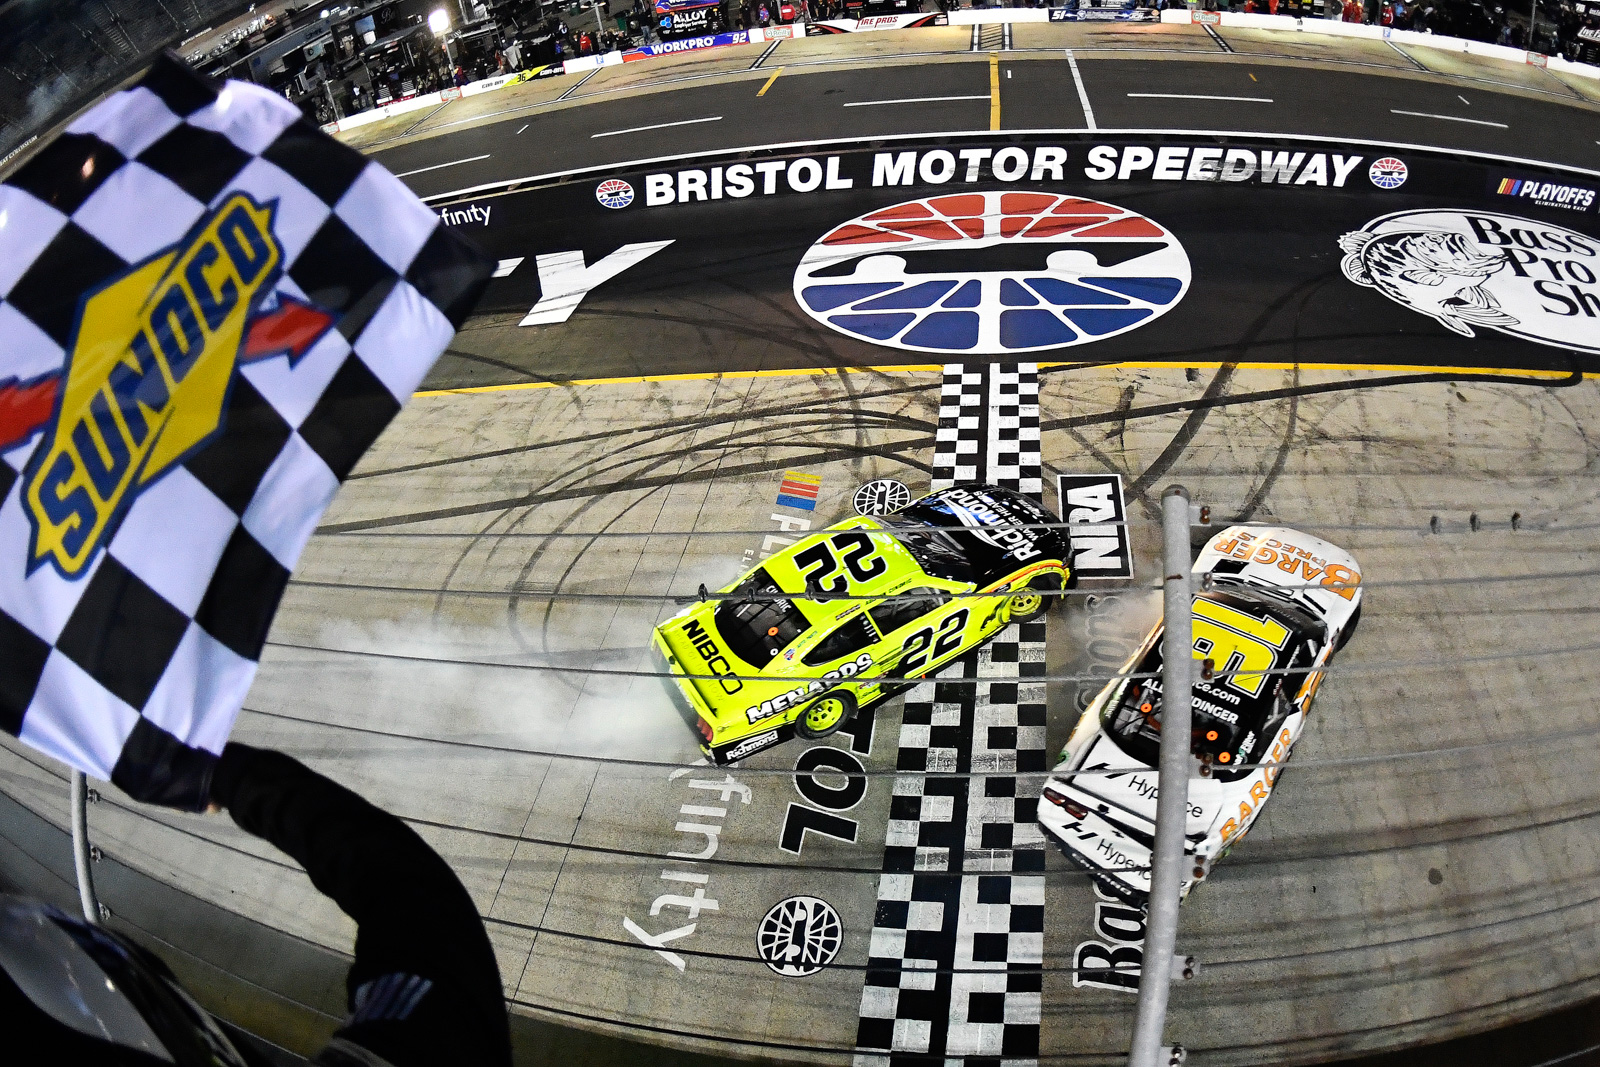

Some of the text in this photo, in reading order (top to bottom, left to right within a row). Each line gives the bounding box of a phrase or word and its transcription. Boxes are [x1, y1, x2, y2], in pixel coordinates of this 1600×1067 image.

[673, 9, 707, 24] ALLOY
[856, 16, 898, 30] TIRE PROS
[1052, 10, 1065, 20] 51
[651, 32, 747, 55] WORKPRO 92
[517, 73, 526, 82] 36
[645, 146, 1364, 207] BRISTOL MOTOR SPEEDWAY
[1520, 181, 1596, 206] PLAYOFFS
[437, 204, 492, 226] finity
[1464, 215, 1597, 257] Bass
[1501, 247, 1597, 285] Pro
[38, 204, 272, 560] SUNOCO
[951, 488, 1042, 561] Richmond
[1012, 516, 1040, 542] WAER
[1066, 482, 1122, 569] NRA
[793, 525, 889, 604] 22
[1213, 534, 1362, 601] BARGER
[682, 618, 743, 695] NIBCO
[904, 607, 969, 677] 22
[745, 653, 874, 725] MENARDS
[725, 731, 779, 760] Richmond
[1220, 728, 1292, 844] BARGER
